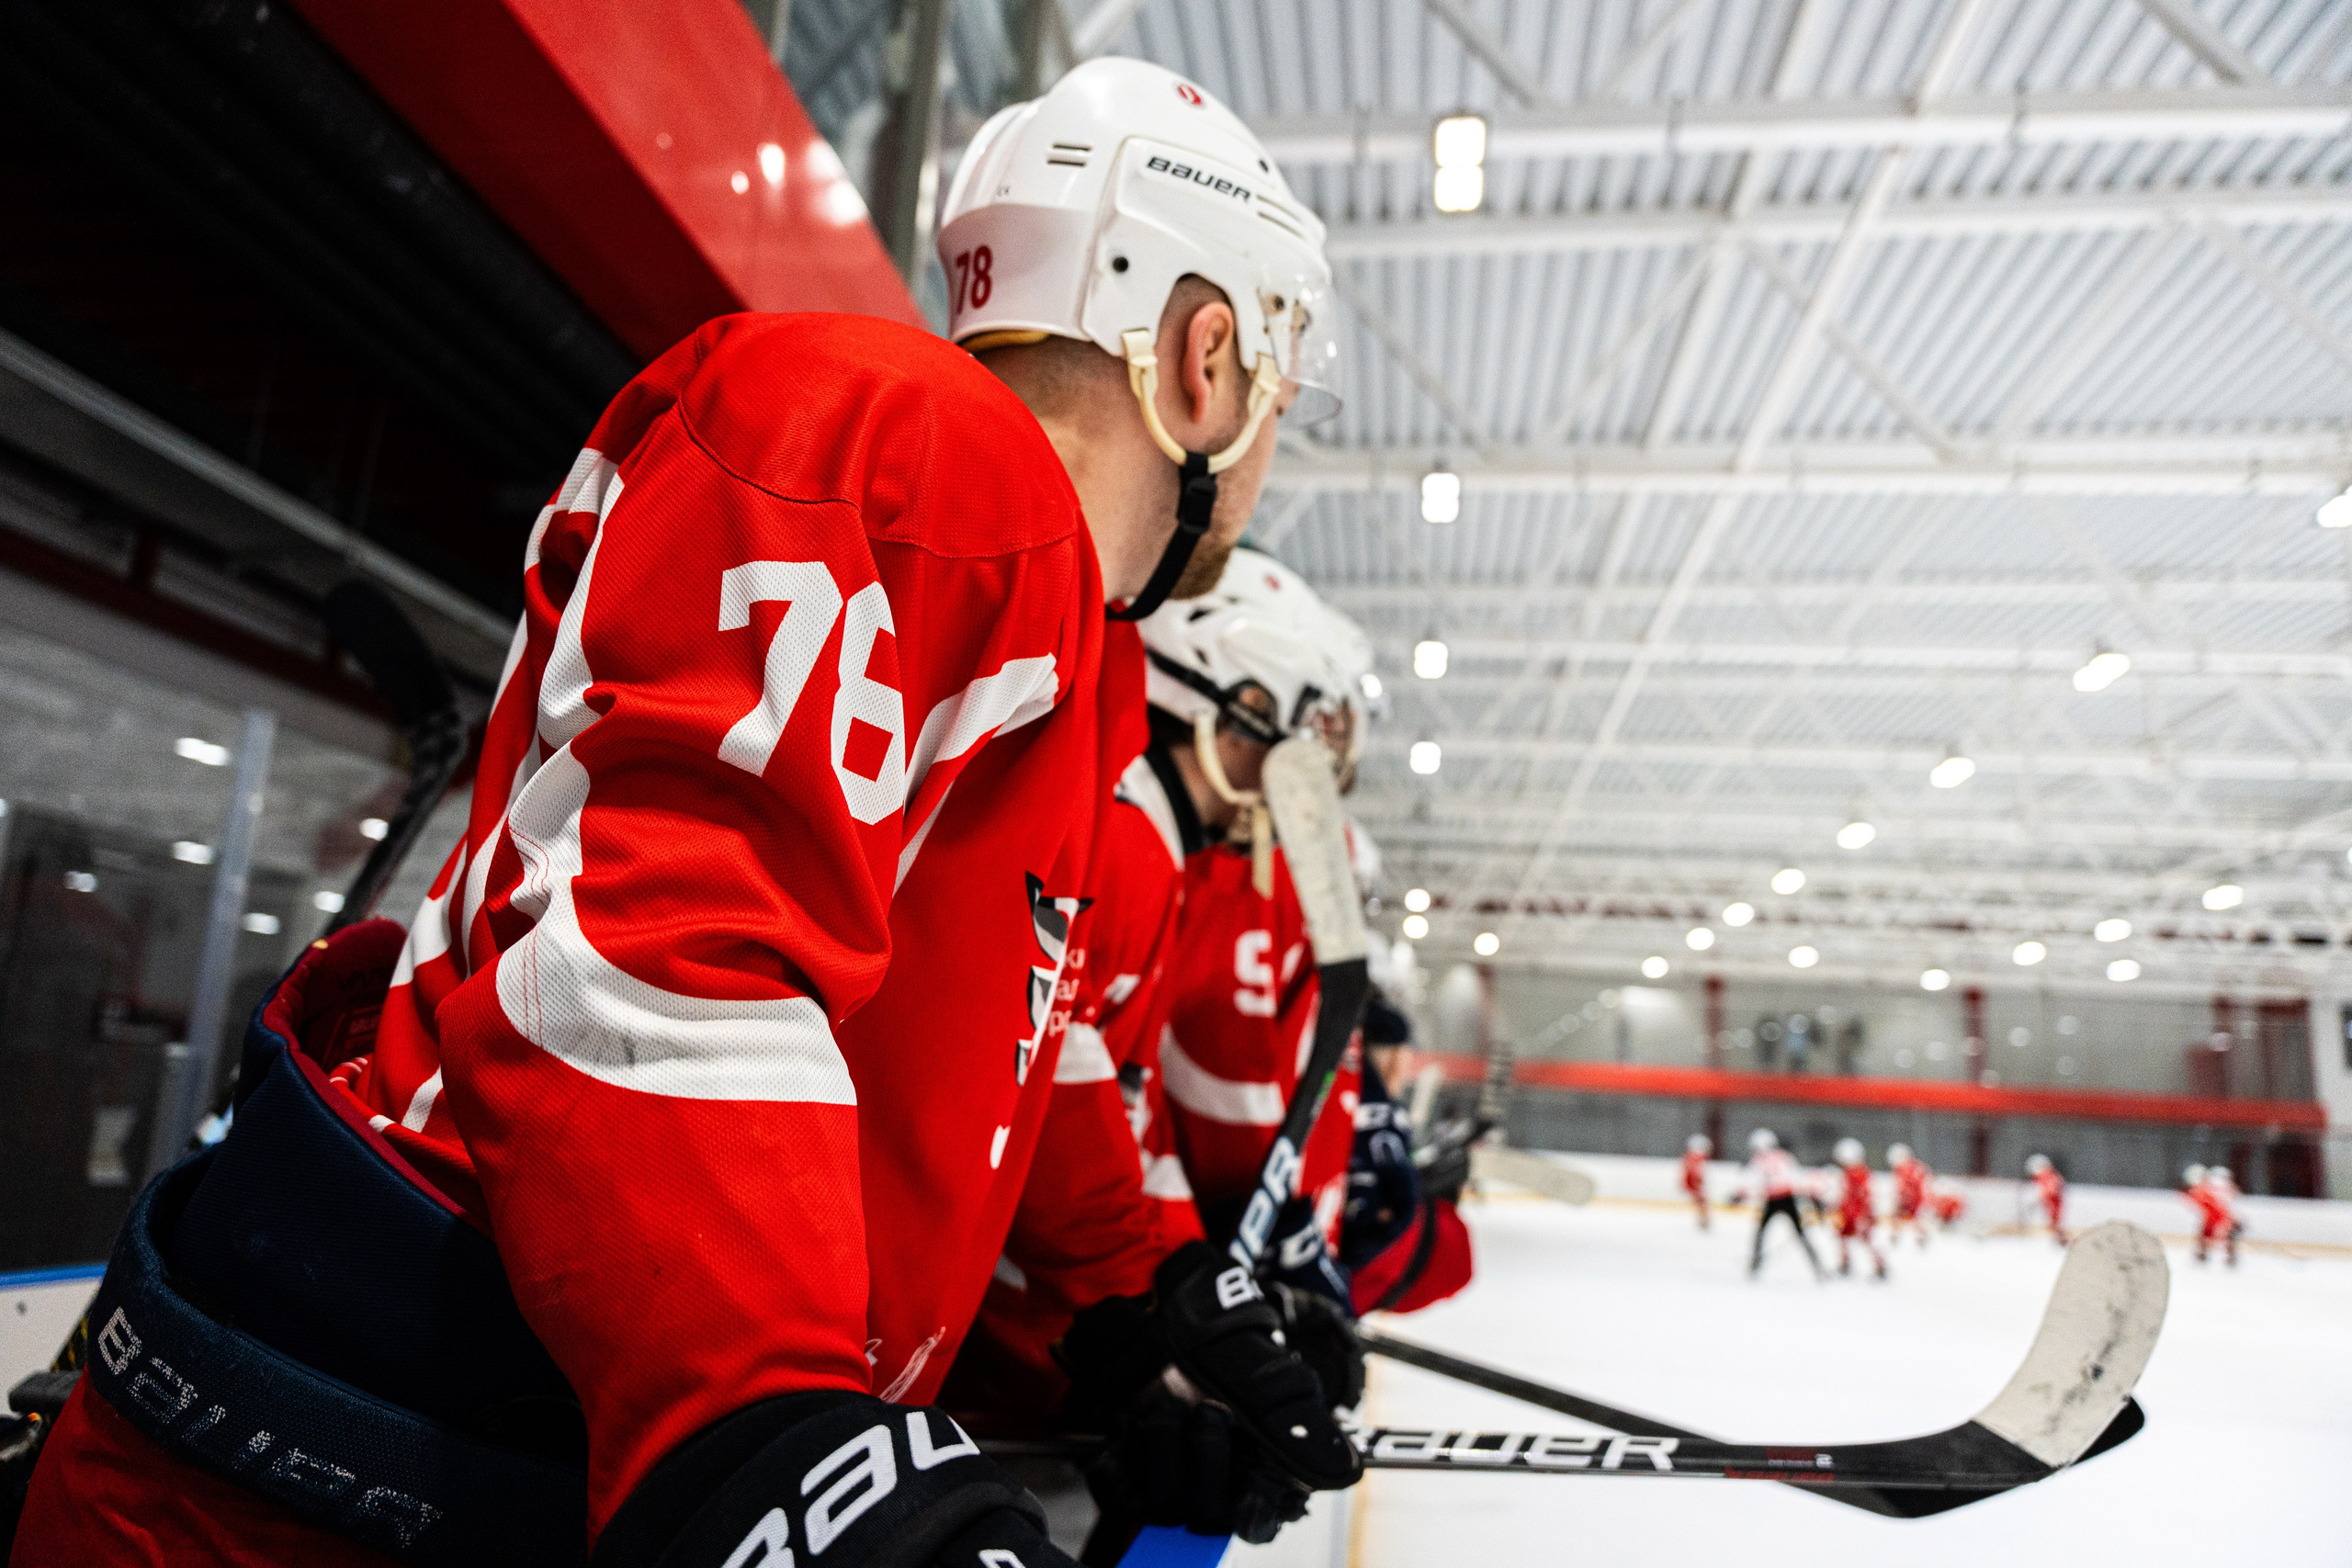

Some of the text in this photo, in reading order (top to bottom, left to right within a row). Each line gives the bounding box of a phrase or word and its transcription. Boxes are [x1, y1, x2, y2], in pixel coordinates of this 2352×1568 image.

[1147, 156, 1251, 202] BAUER
[956, 245, 991, 315] 78
[718, 560, 906, 825] 76
